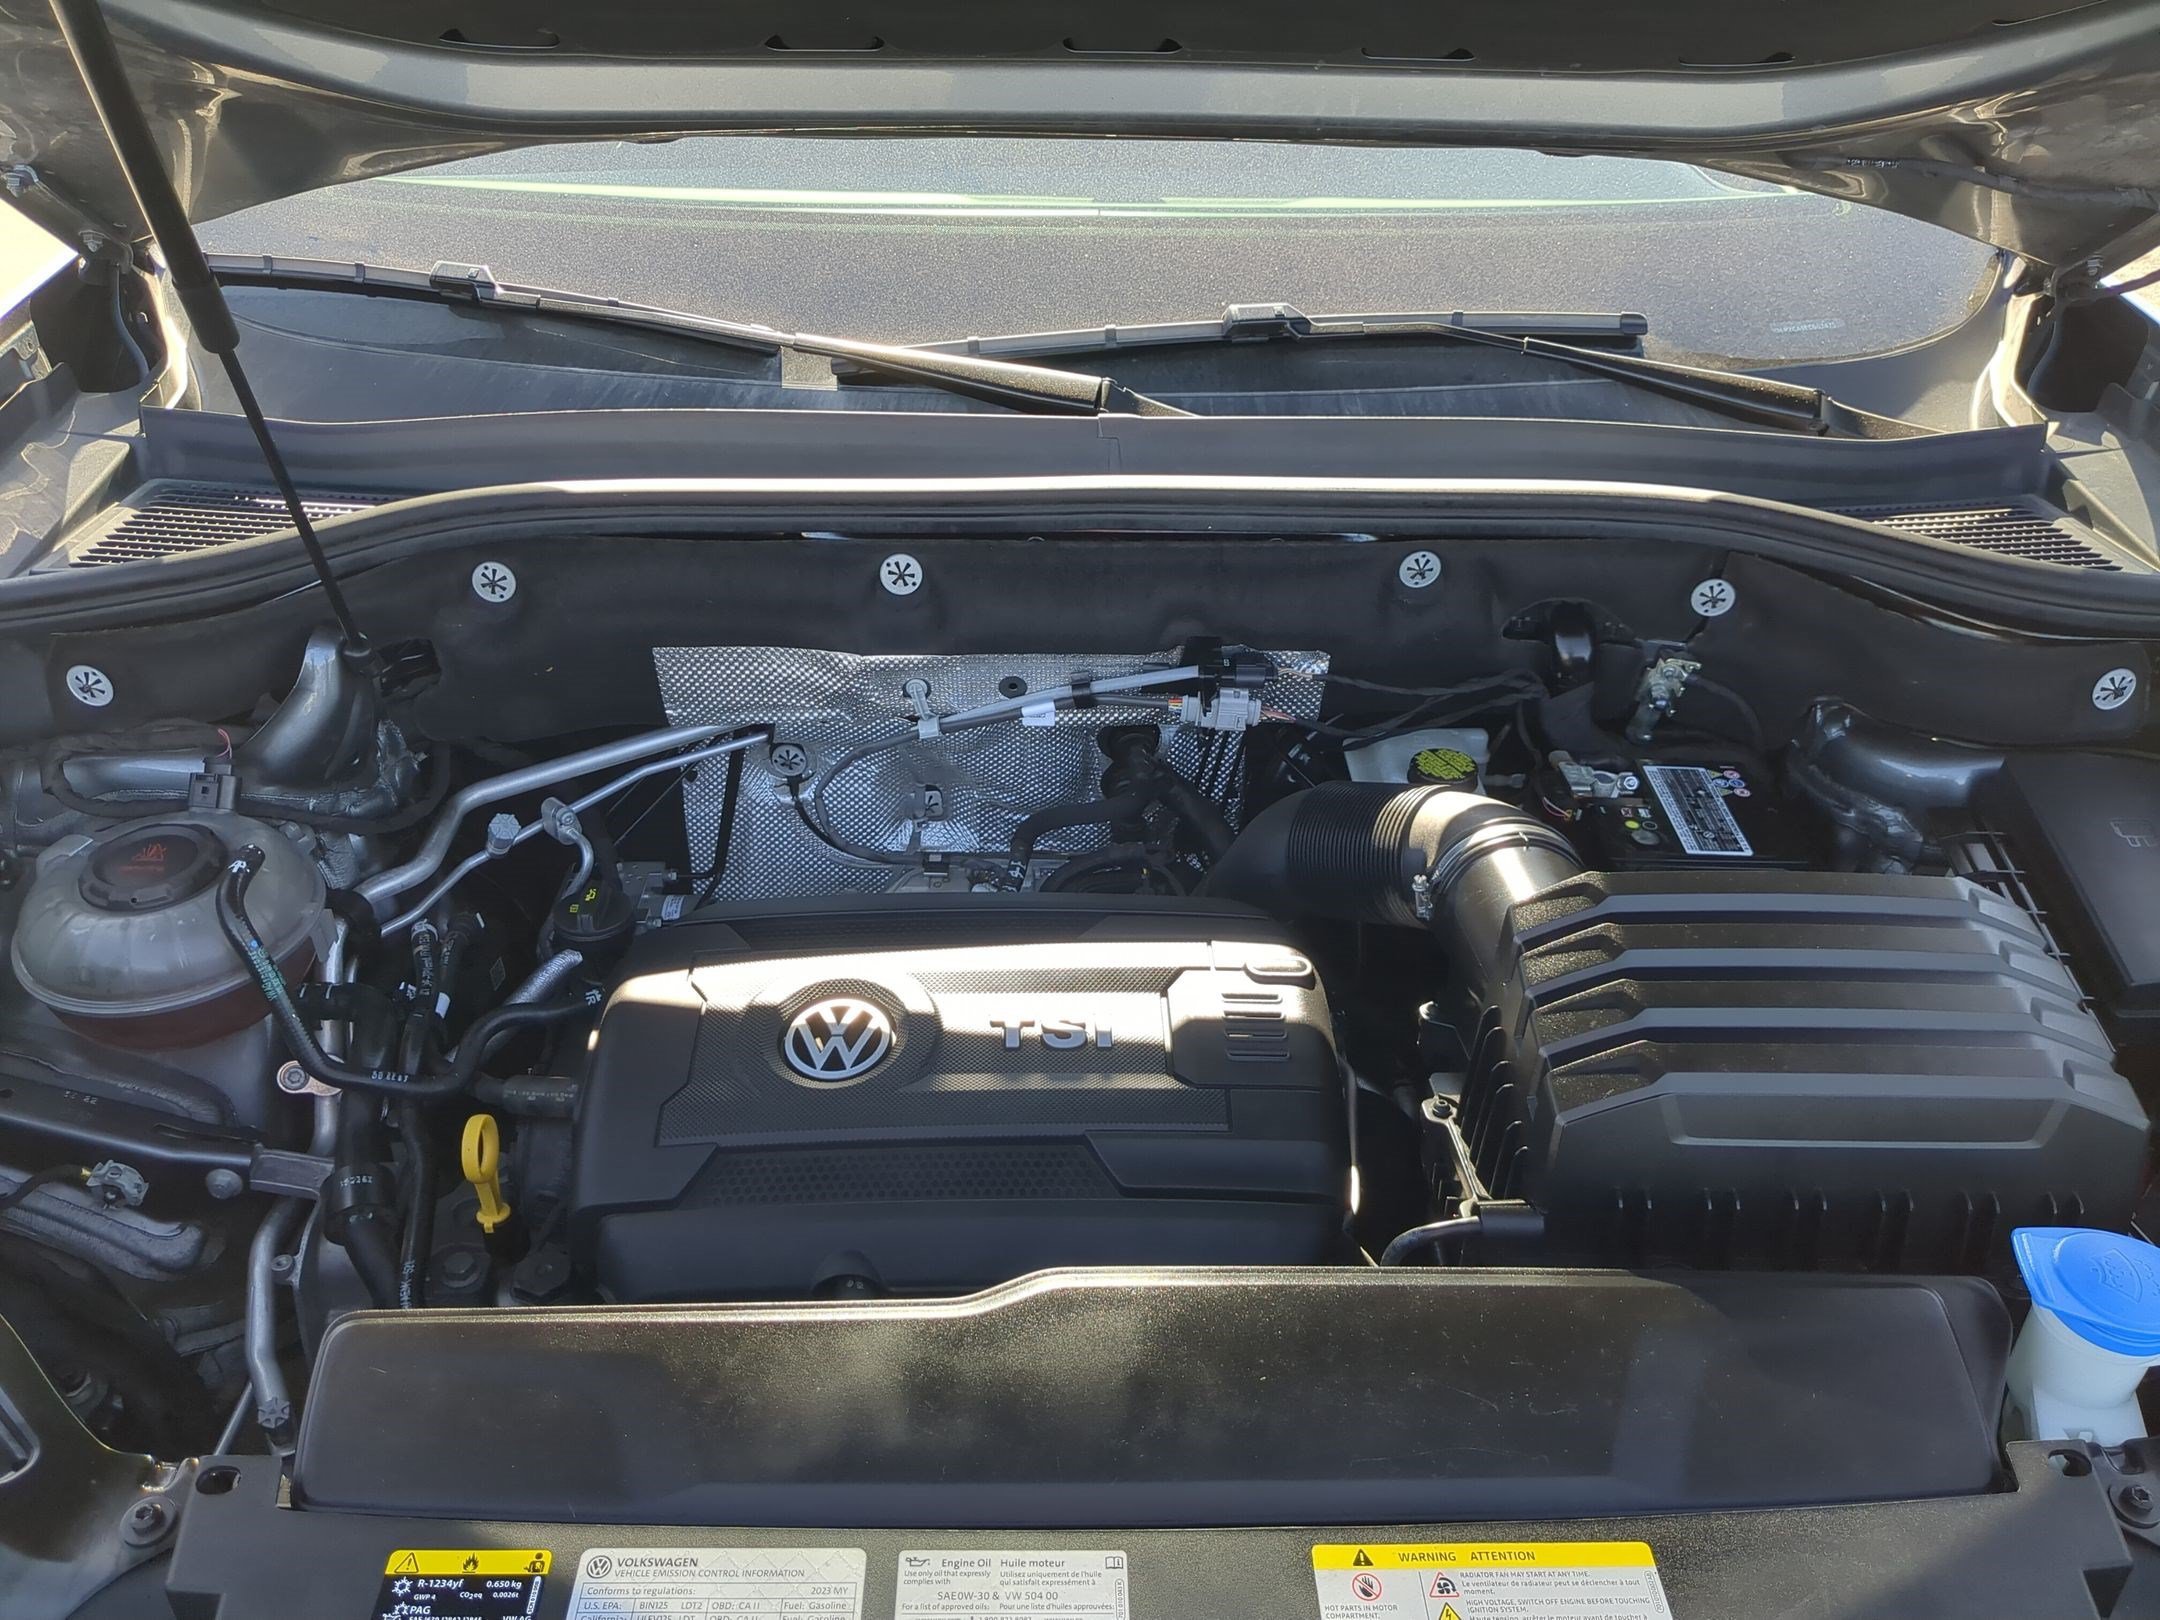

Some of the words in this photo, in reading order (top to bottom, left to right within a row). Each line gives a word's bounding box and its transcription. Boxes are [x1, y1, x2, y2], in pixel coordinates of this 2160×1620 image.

[990, 1019, 1113, 1049] TSI
[1399, 1552, 1456, 1562] WARNING
[1471, 1551, 1535, 1561] ATTENTION
[617, 1557, 699, 1567] VOLKSWAGEN
[942, 1558, 975, 1569] Engine
[978, 1558, 991, 1567] Oil
[1000, 1558, 1026, 1568] Huile
[1029, 1559, 1065, 1568] moteur
[615, 1569, 650, 1577] VEHICLE
[653, 1569, 695, 1577] EMISSION
[698, 1569, 740, 1577] CONTROL
[742, 1569, 805, 1577] INFORMATION
[918, 1570, 933, 1578] only
[959, 1570, 991, 1578] expressly
[1027, 1571, 1069, 1579] uniquement
[417, 1579, 464, 1590] R-1234yf
[486, 1580, 509, 1588] 0.650
[511, 1580, 522, 1590] kg
[999, 1579, 1012, 1587] qui
[1042, 1579, 1090, 1587] expressément
[1554, 1580, 1570, 1588] peut
[587, 1586, 629, 1595] Conforms
[632, 1587, 641, 1595] to
[643, 1586, 696, 1596] regulations:
[811, 1587, 831, 1595] 2023
[833, 1587, 849, 1595] MY
[992, 1592, 1000, 1601] &
[1005, 1591, 1022, 1600] VW
[1025, 1591, 1043, 1600] 504
[1045, 1591, 1059, 1600] 00
[409, 1605, 431, 1615] PAG
[584, 1602, 600, 1610] U.S.
[602, 1602, 622, 1610] EPA:
[639, 1602, 669, 1610] BIN125
[681, 1602, 703, 1610] LDT2
[712, 1602, 734, 1610] OBD:
[738, 1602, 751, 1610] CA
[784, 1602, 805, 1610] Fuel:
[808, 1602, 847, 1610] Gasoline
[941, 1603, 974, 1612] approved
